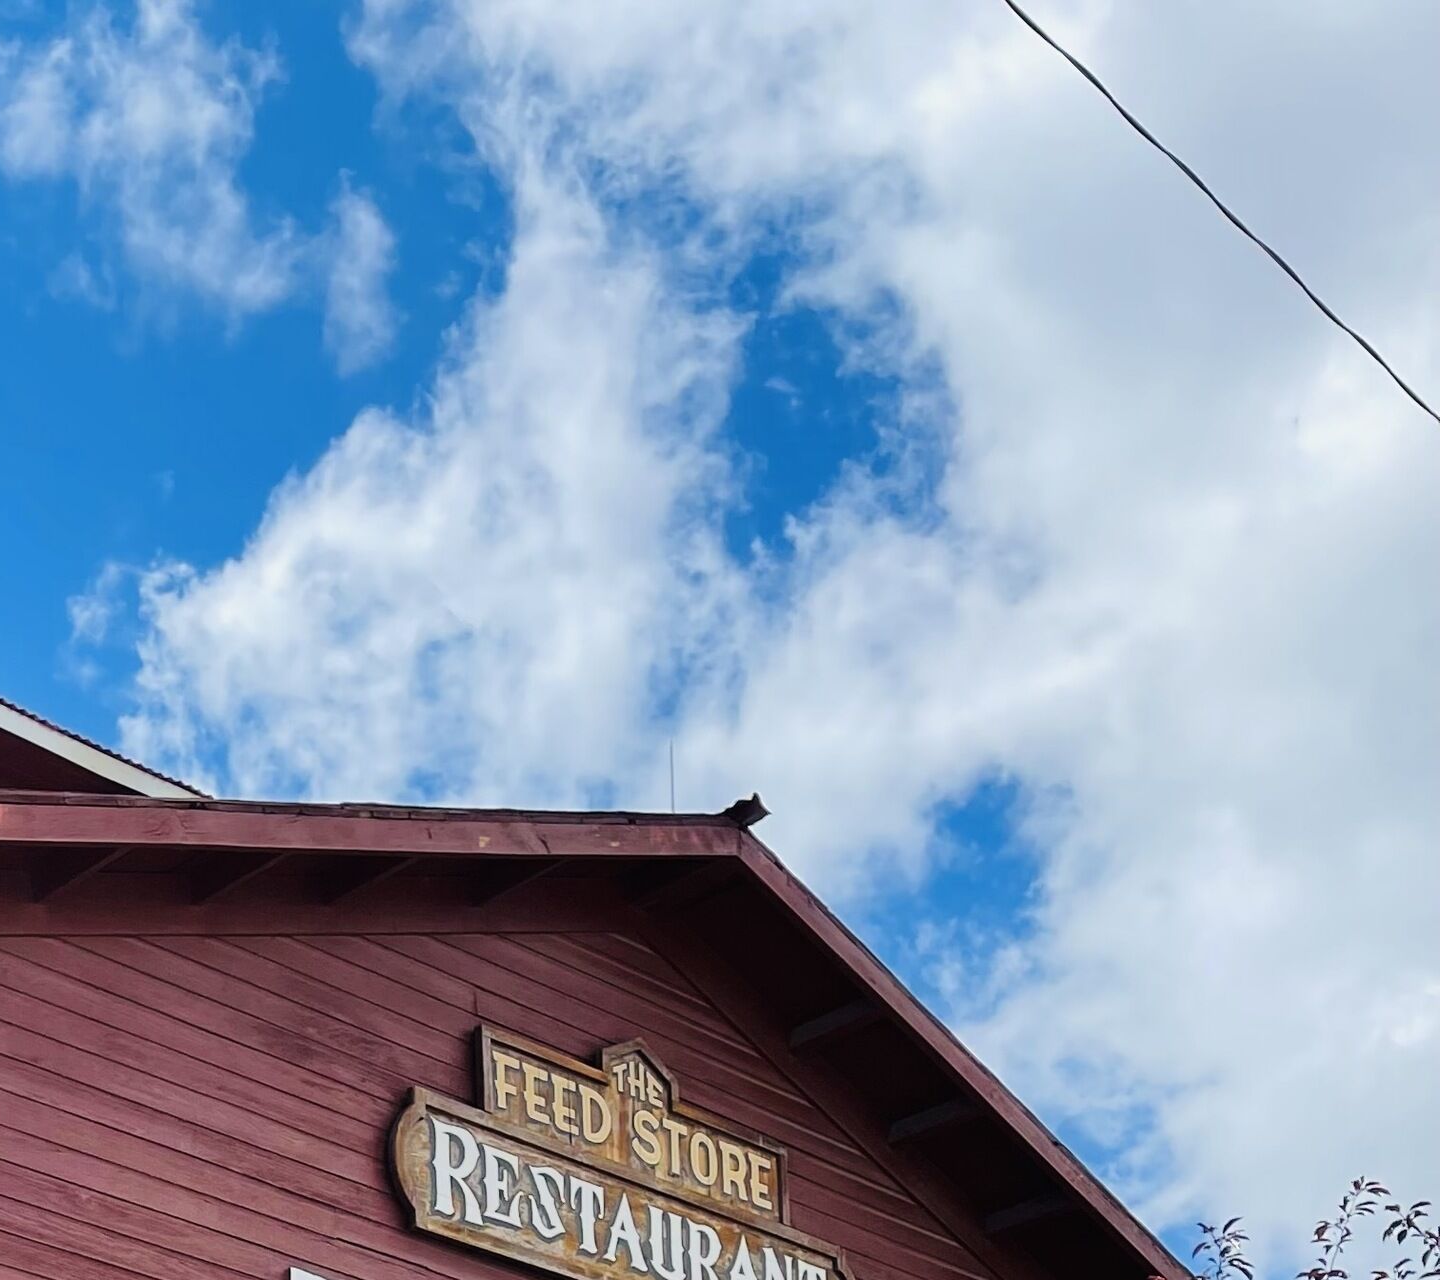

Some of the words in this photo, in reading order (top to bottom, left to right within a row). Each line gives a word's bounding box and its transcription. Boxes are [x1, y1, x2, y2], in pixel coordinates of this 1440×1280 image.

[492, 1050, 612, 1145] FEED
[631, 1110, 774, 1211] STORE
[612, 1062, 664, 1108] THE
